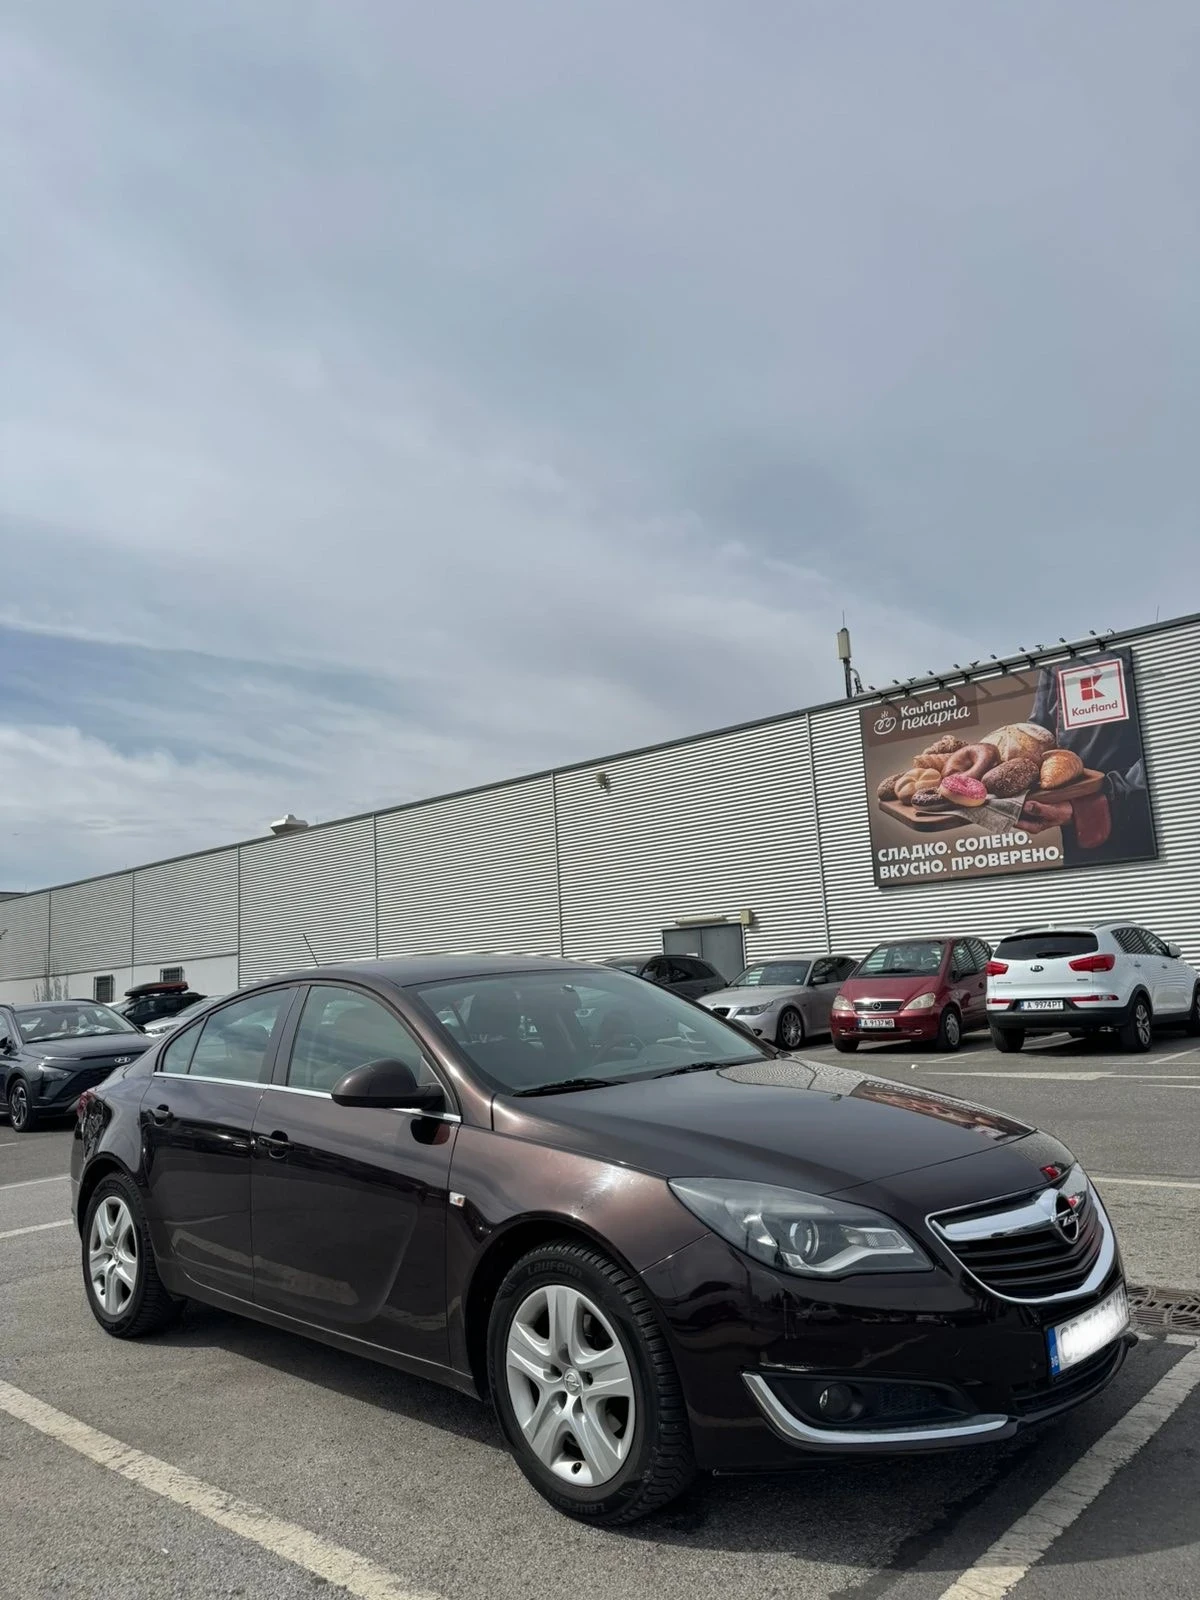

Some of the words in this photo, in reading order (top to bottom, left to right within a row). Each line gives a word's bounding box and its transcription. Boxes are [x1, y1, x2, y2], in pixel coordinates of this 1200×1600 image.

[900, 695, 957, 717] Kaufland
[901, 706, 971, 731] пекарна
[1071, 700, 1118, 717] Kaufland
[878, 841, 952, 862] СЛАДКО.
[955, 831, 1032, 853] СОЛЕНО.
[879, 859, 947, 879] ВКУСНО.
[951, 846, 1064, 871] ПРОВЕРЕНО.
